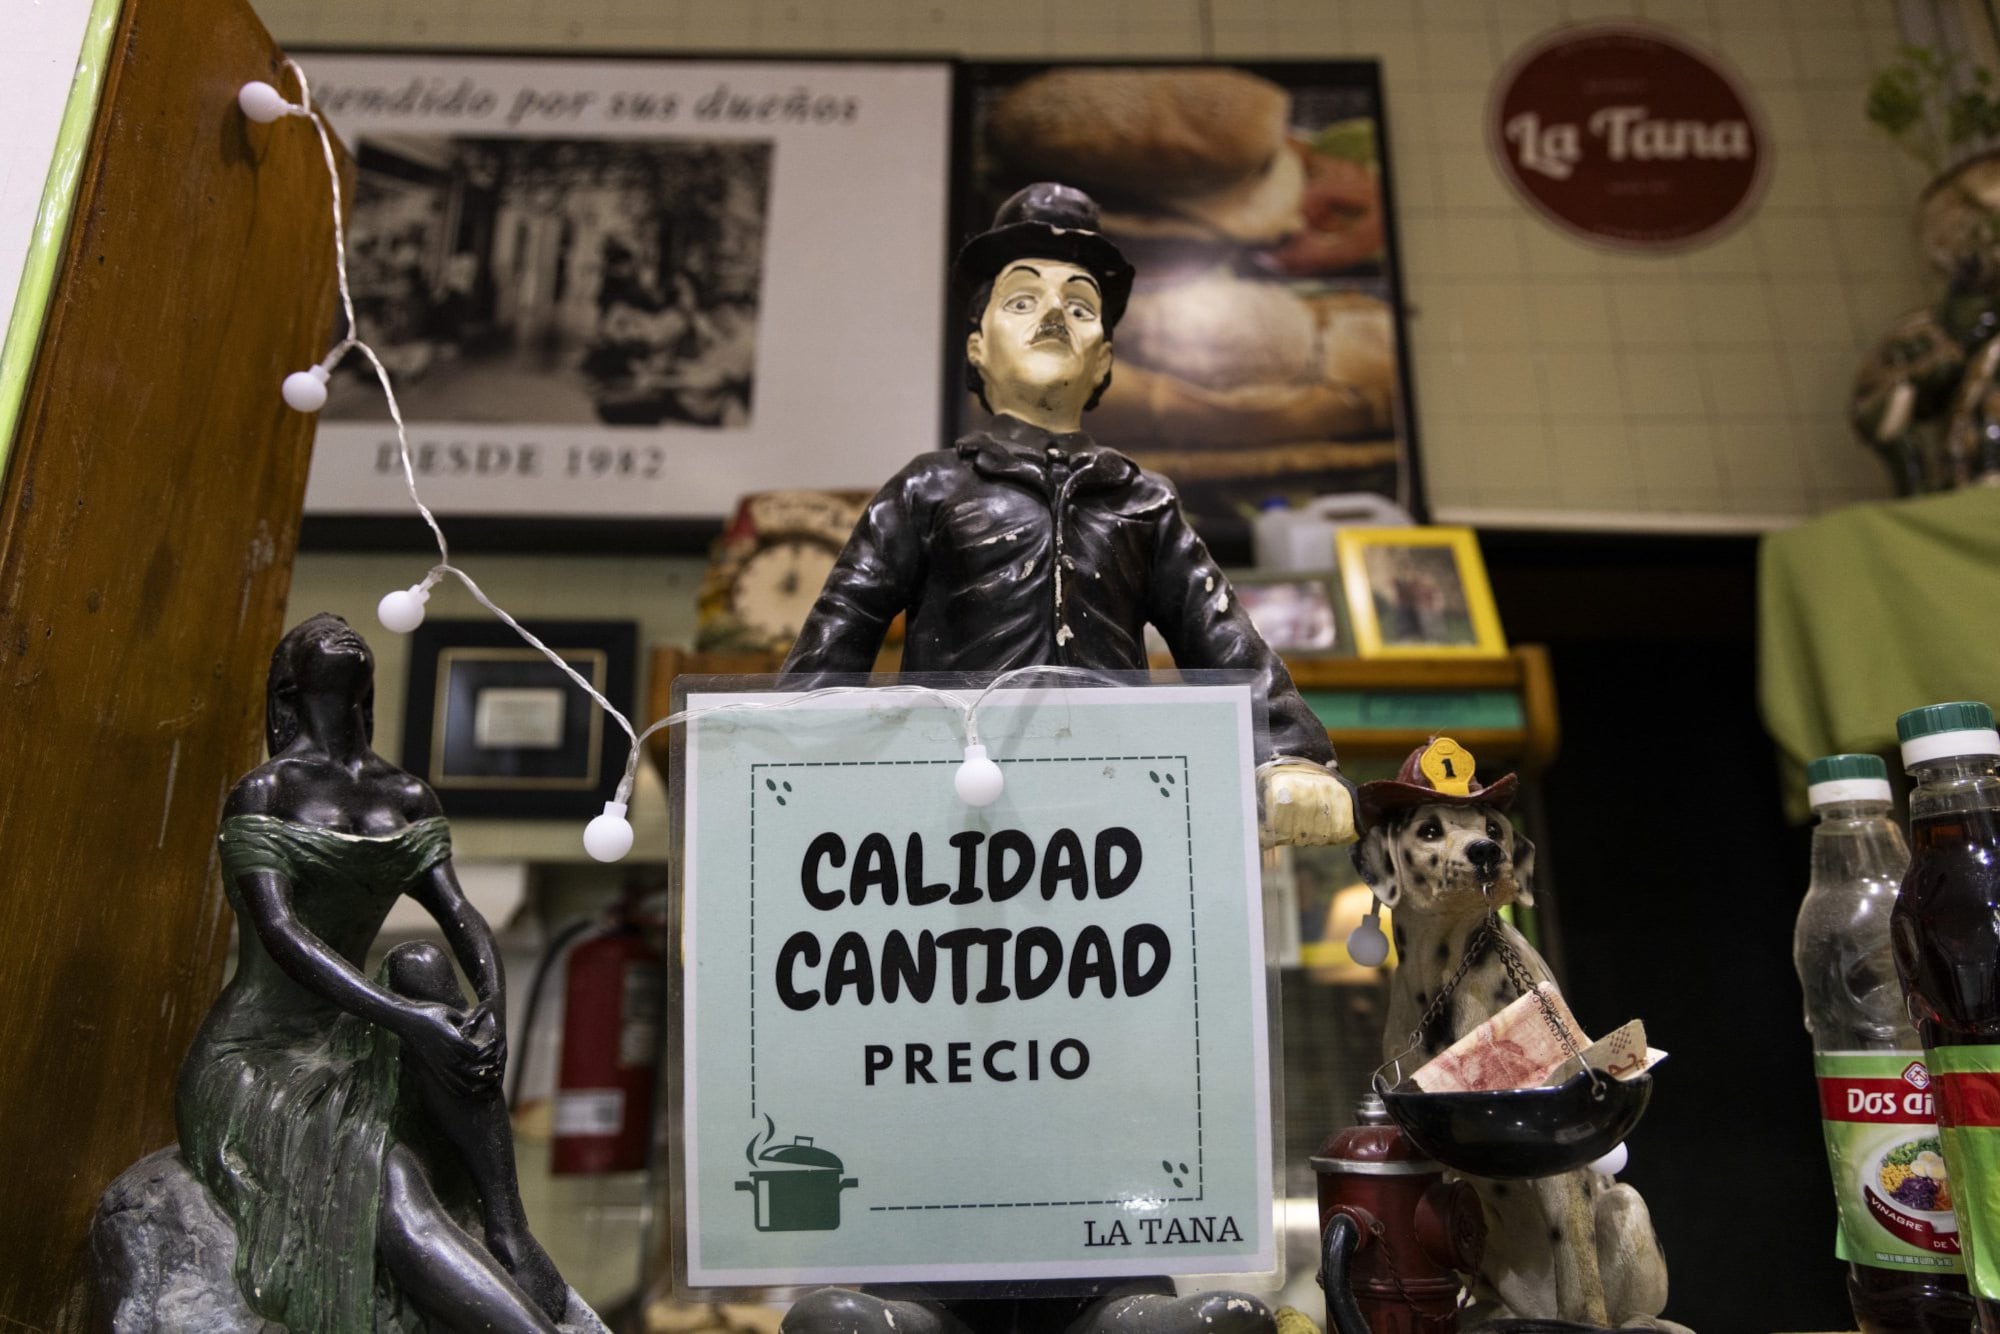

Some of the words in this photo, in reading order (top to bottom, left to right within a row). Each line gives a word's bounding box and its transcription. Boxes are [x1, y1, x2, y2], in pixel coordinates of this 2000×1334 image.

[502, 88, 596, 127] por
[606, 91, 680, 122] sus
[1506, 110, 1581, 181] La
[1589, 105, 1750, 161] Tana
[374, 441, 543, 477] DESDE
[1441, 758, 1457, 778] 1
[801, 826, 1142, 911] CALIDAD
[775, 923, 1171, 1011] CANTIDAD
[864, 1038, 1090, 1086] PRECIO
[1084, 1220, 1132, 1247] LA
[1139, 1216, 1244, 1245] TANA
[1871, 1197, 1923, 1232] VINAGRE
[1933, 1240, 1948, 1249] DE
